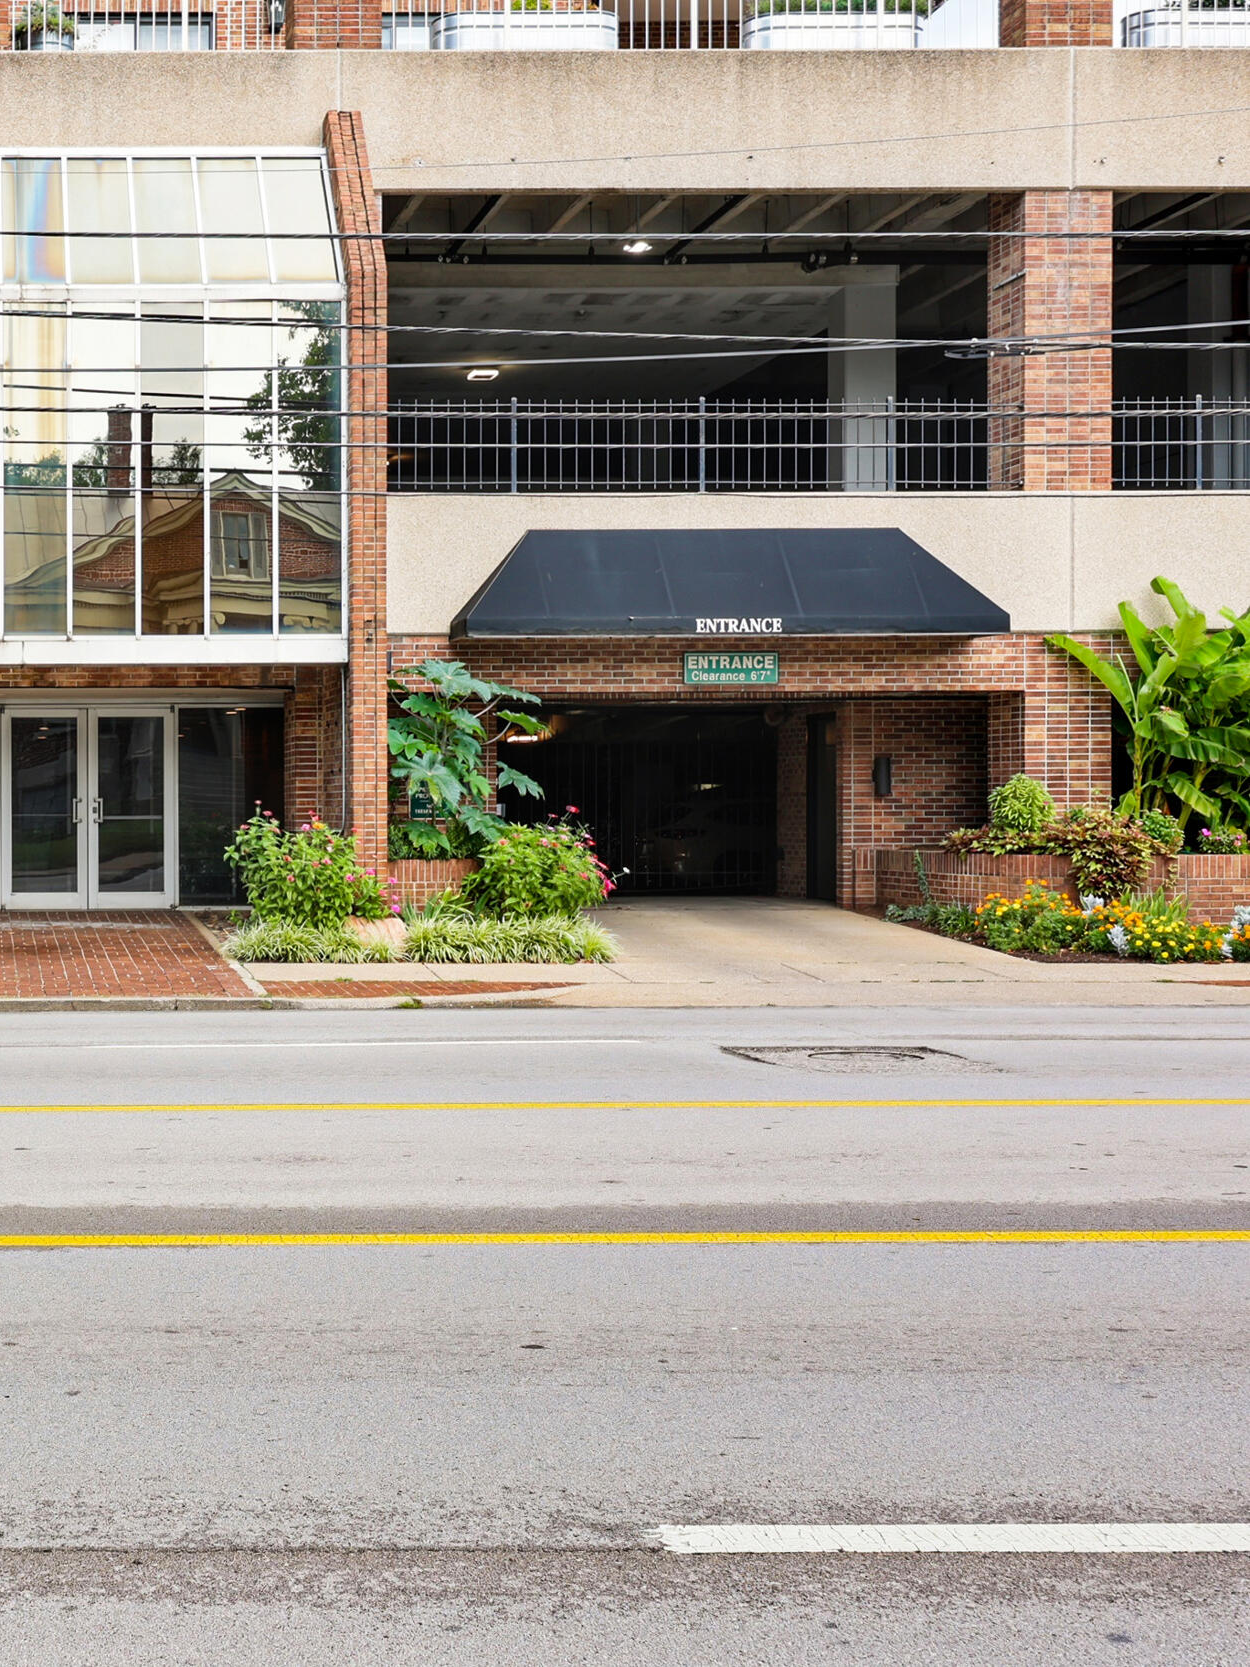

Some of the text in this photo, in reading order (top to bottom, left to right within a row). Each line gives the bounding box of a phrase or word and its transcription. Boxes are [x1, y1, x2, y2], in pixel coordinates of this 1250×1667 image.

[695, 618, 783, 633] ENTRANCE
[687, 656, 775, 669] ENTRANCE
[691, 671, 746, 681] Clearance
